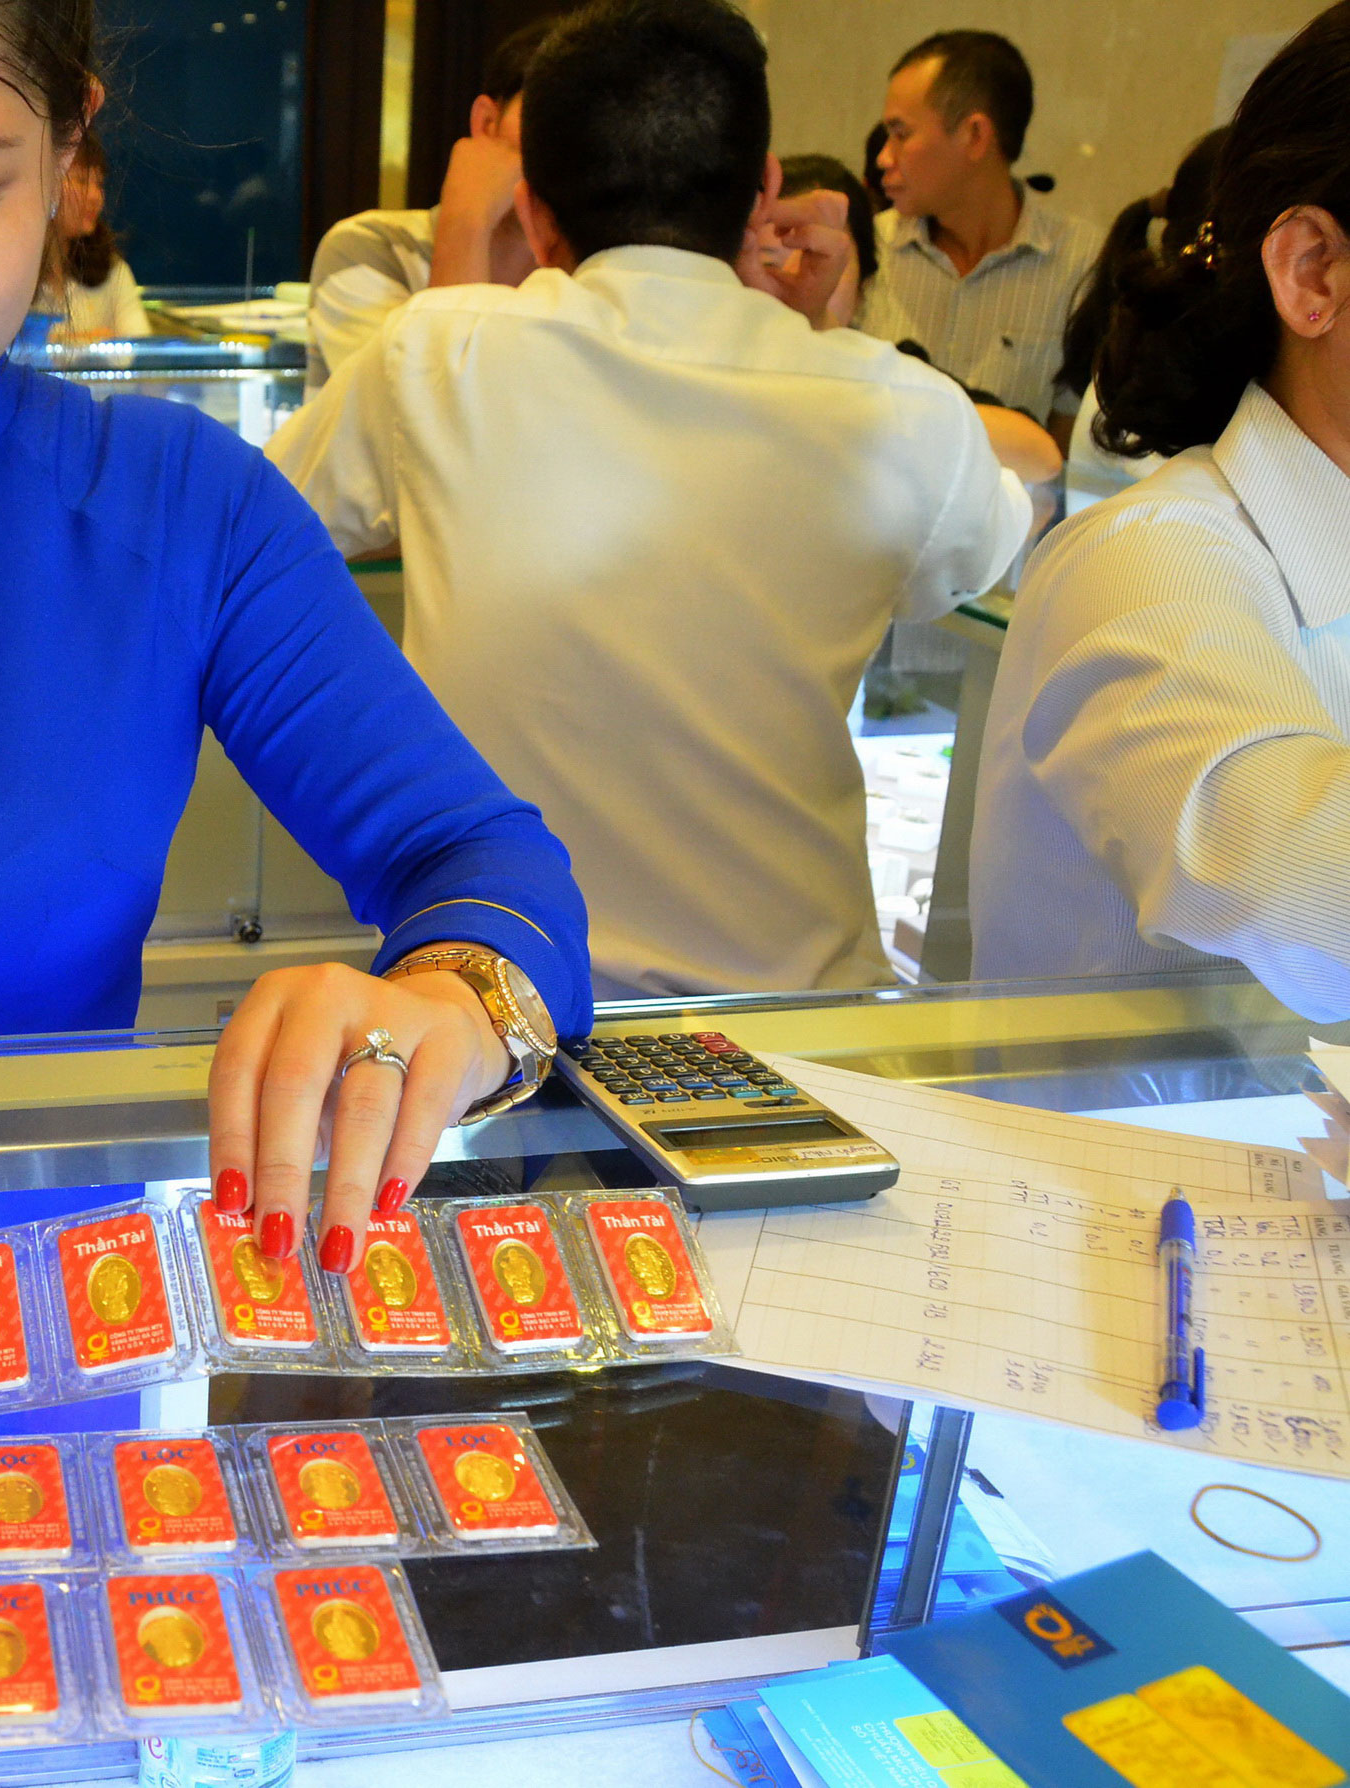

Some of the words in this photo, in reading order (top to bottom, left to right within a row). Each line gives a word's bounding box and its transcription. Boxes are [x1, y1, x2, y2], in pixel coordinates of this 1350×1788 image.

[386, 1221, 410, 1232] Tài
[472, 1222, 512, 1236] Thần
[514, 1221, 540, 1234] Tài
[601, 1214, 640, 1229] Thần
[640, 1214, 665, 1227] Tài
[74, 1237, 117, 1256] Thần
[118, 1230, 145, 1246] Tài
[294, 1440, 346, 1456] LỘC
[445, 1433, 498, 1448] LỘC
[141, 1447, 194, 1463] LỘC
[294, 1578, 372, 1597] PHÚC
[128, 1588, 206, 1606] PHÚC
